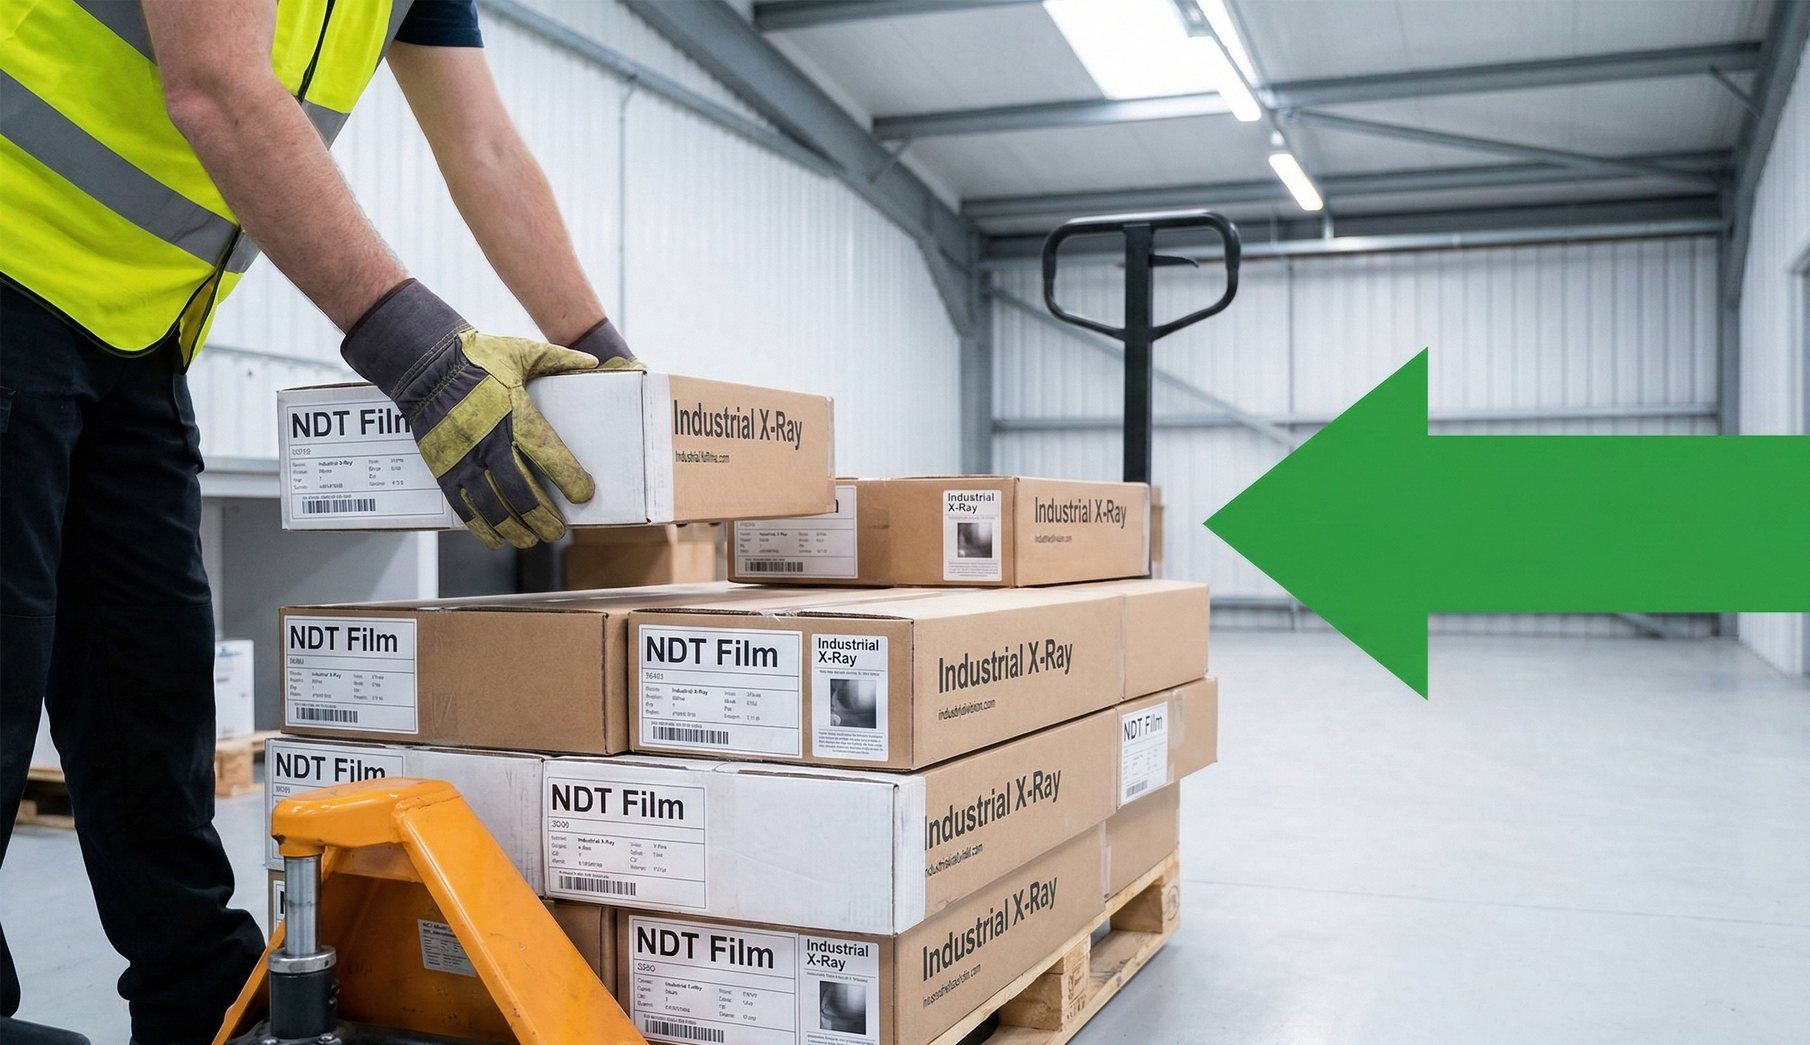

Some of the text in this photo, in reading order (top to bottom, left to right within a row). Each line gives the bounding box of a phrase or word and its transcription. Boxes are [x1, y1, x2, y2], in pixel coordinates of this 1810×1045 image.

[292, 410, 350, 438] NDT
[674, 399, 803, 451] Industrial X-Ray
[947, 492, 995, 502] Industrial
[948, 503, 978, 514] X-Ray
[1035, 497, 1127, 529] Industrial X-Ray
[290, 625, 398, 653] NDT Film
[646, 636, 778, 668] NDT Film
[818, 651, 857, 667] X-Ray
[939, 639, 1073, 694] Industrial X-Ray
[1124, 717, 1143, 742] NDT
[276, 752, 386, 783] NDT Film
[552, 783, 684, 820] NDT Film
[925, 770, 1062, 851] Industrial X-Ray
[923, 876, 1058, 982] Industrial X-Ray
[637, 926, 774, 969] NDT Film
[806, 938, 869, 957] Industrial
[806, 952, 846, 972] X-Ray
